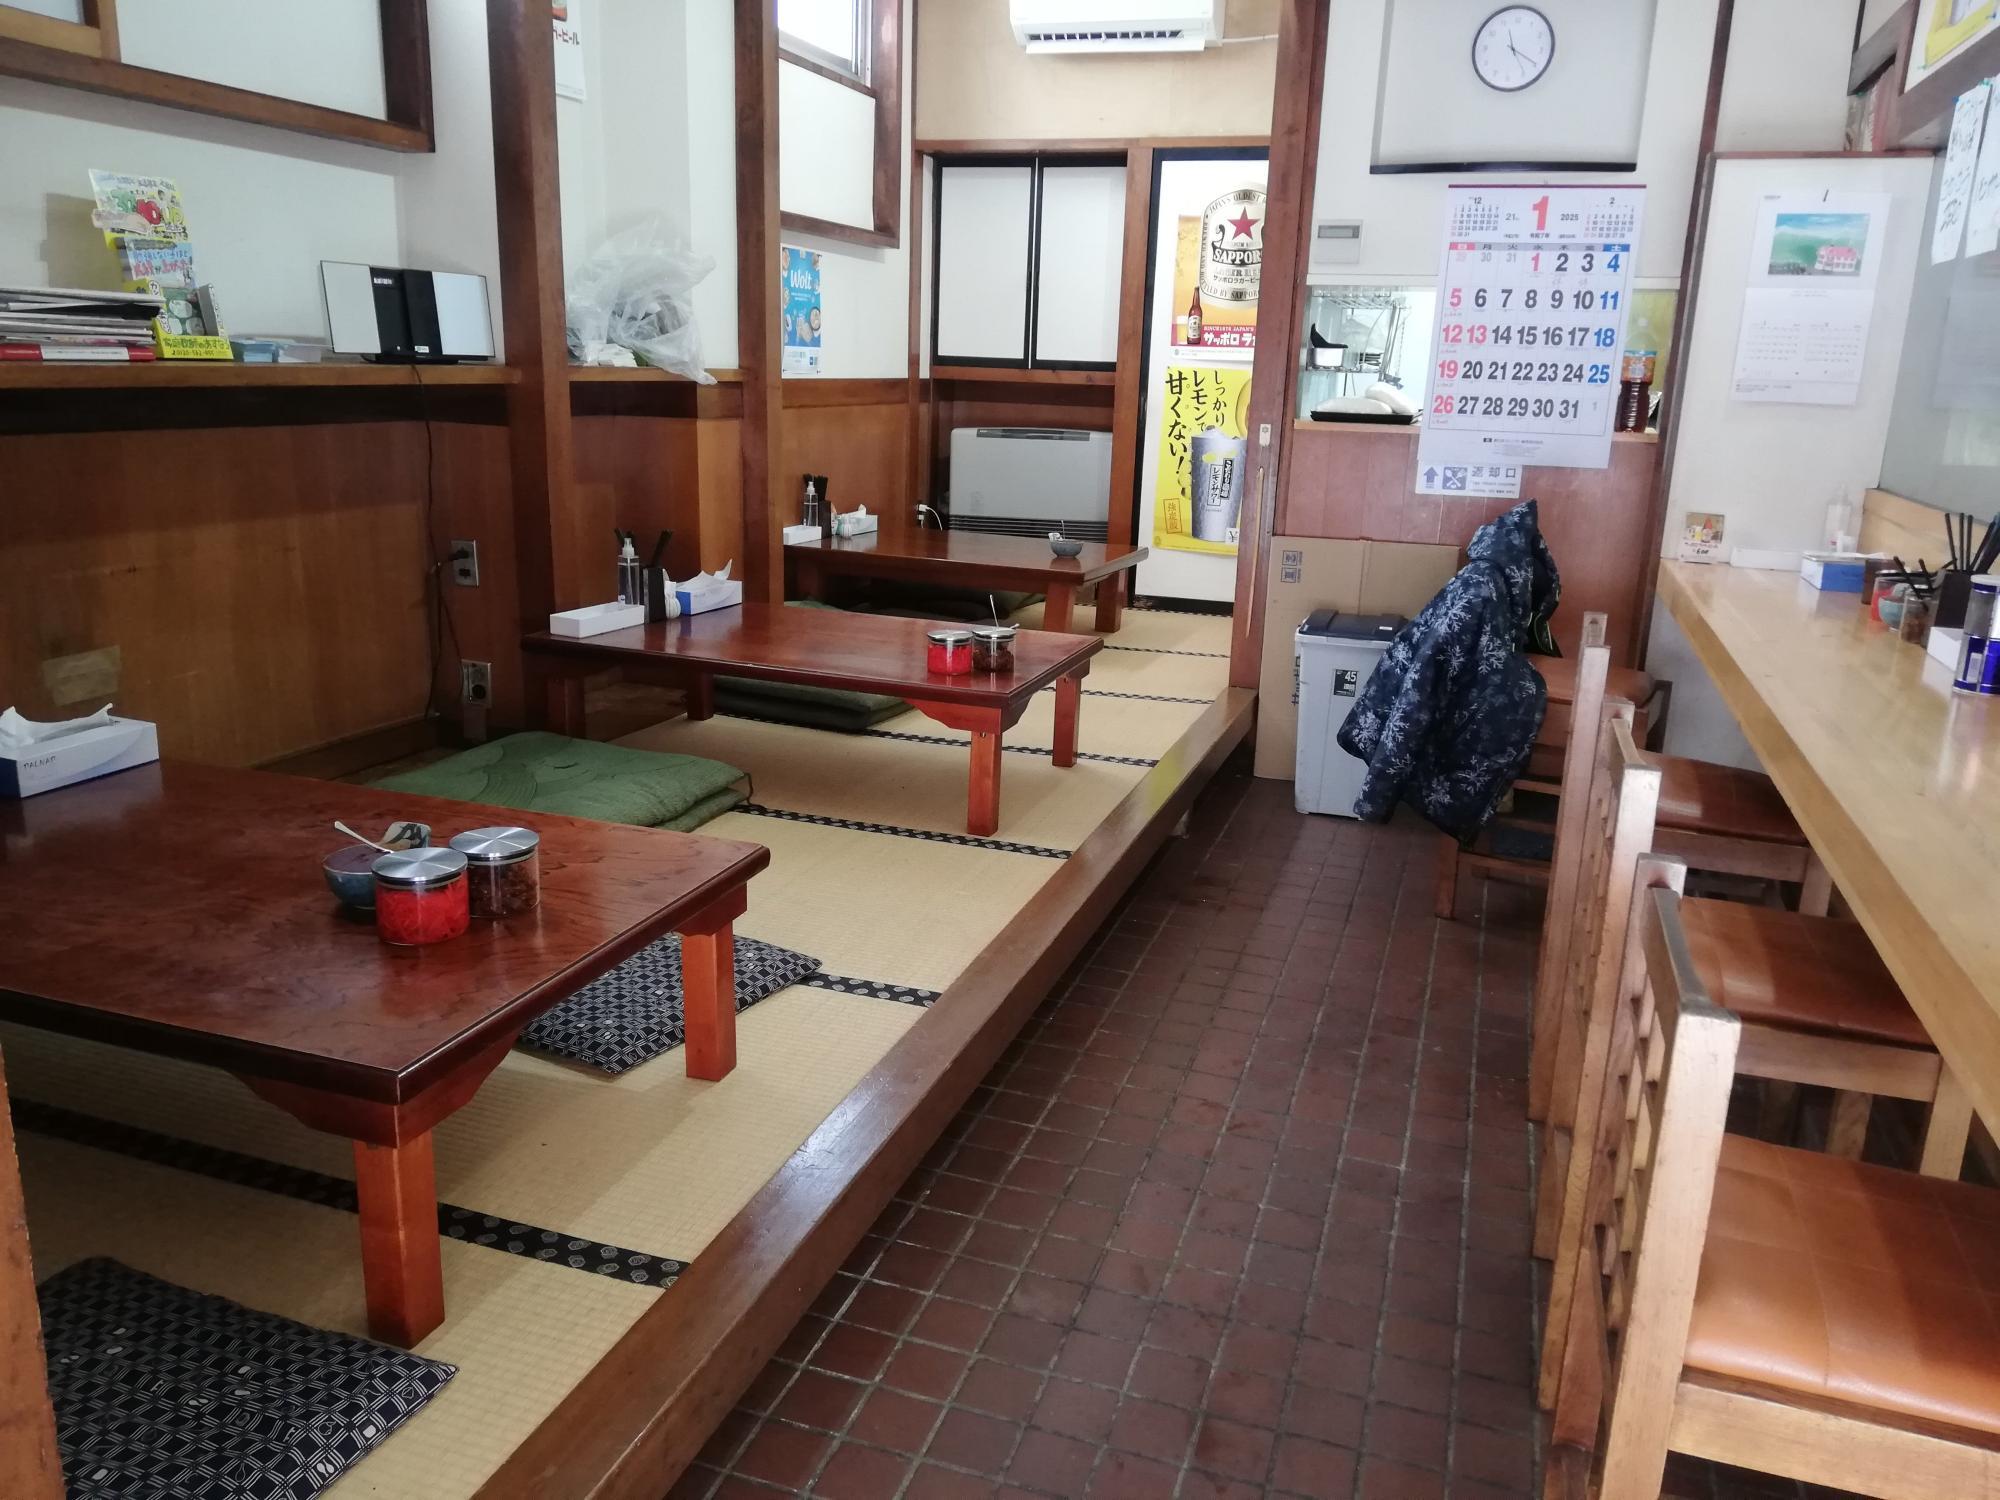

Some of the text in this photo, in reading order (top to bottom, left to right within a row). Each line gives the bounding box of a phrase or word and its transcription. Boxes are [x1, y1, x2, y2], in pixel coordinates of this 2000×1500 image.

[1532, 195, 1549, 231] 1
[1560, 213, 1579, 221] 2025
[1213, 248, 1262, 264] SAPPOR
[1531, 252, 1540, 272] 1
[1555, 252, 1569, 272] 2
[1581, 253, 1594, 272] 3
[1607, 253, 1620, 273] 4
[790, 269, 812, 290] Wolt
[1449, 288, 1619, 310] 5 6 7 8 9 10 11
[1203, 332, 1256, 346] サッポロラ
[1442, 324, 1615, 347] 12 13 14 15 16 17 18
[1438, 360, 1610, 384] 19 20 21 22 23 24 25
[1212, 369, 1227, 427] しっかり
[1433, 394, 1454, 414] 26
[1457, 395, 1480, 415] 27
[1481, 396, 1504, 416] 28
[1506, 397, 1529, 417] 29
[1532, 398, 1554, 418] 30
[1558, 399, 1580, 419] 31
[1472, 466, 1517, 478] 返却口
[1344, 671, 1357, 682] 45
